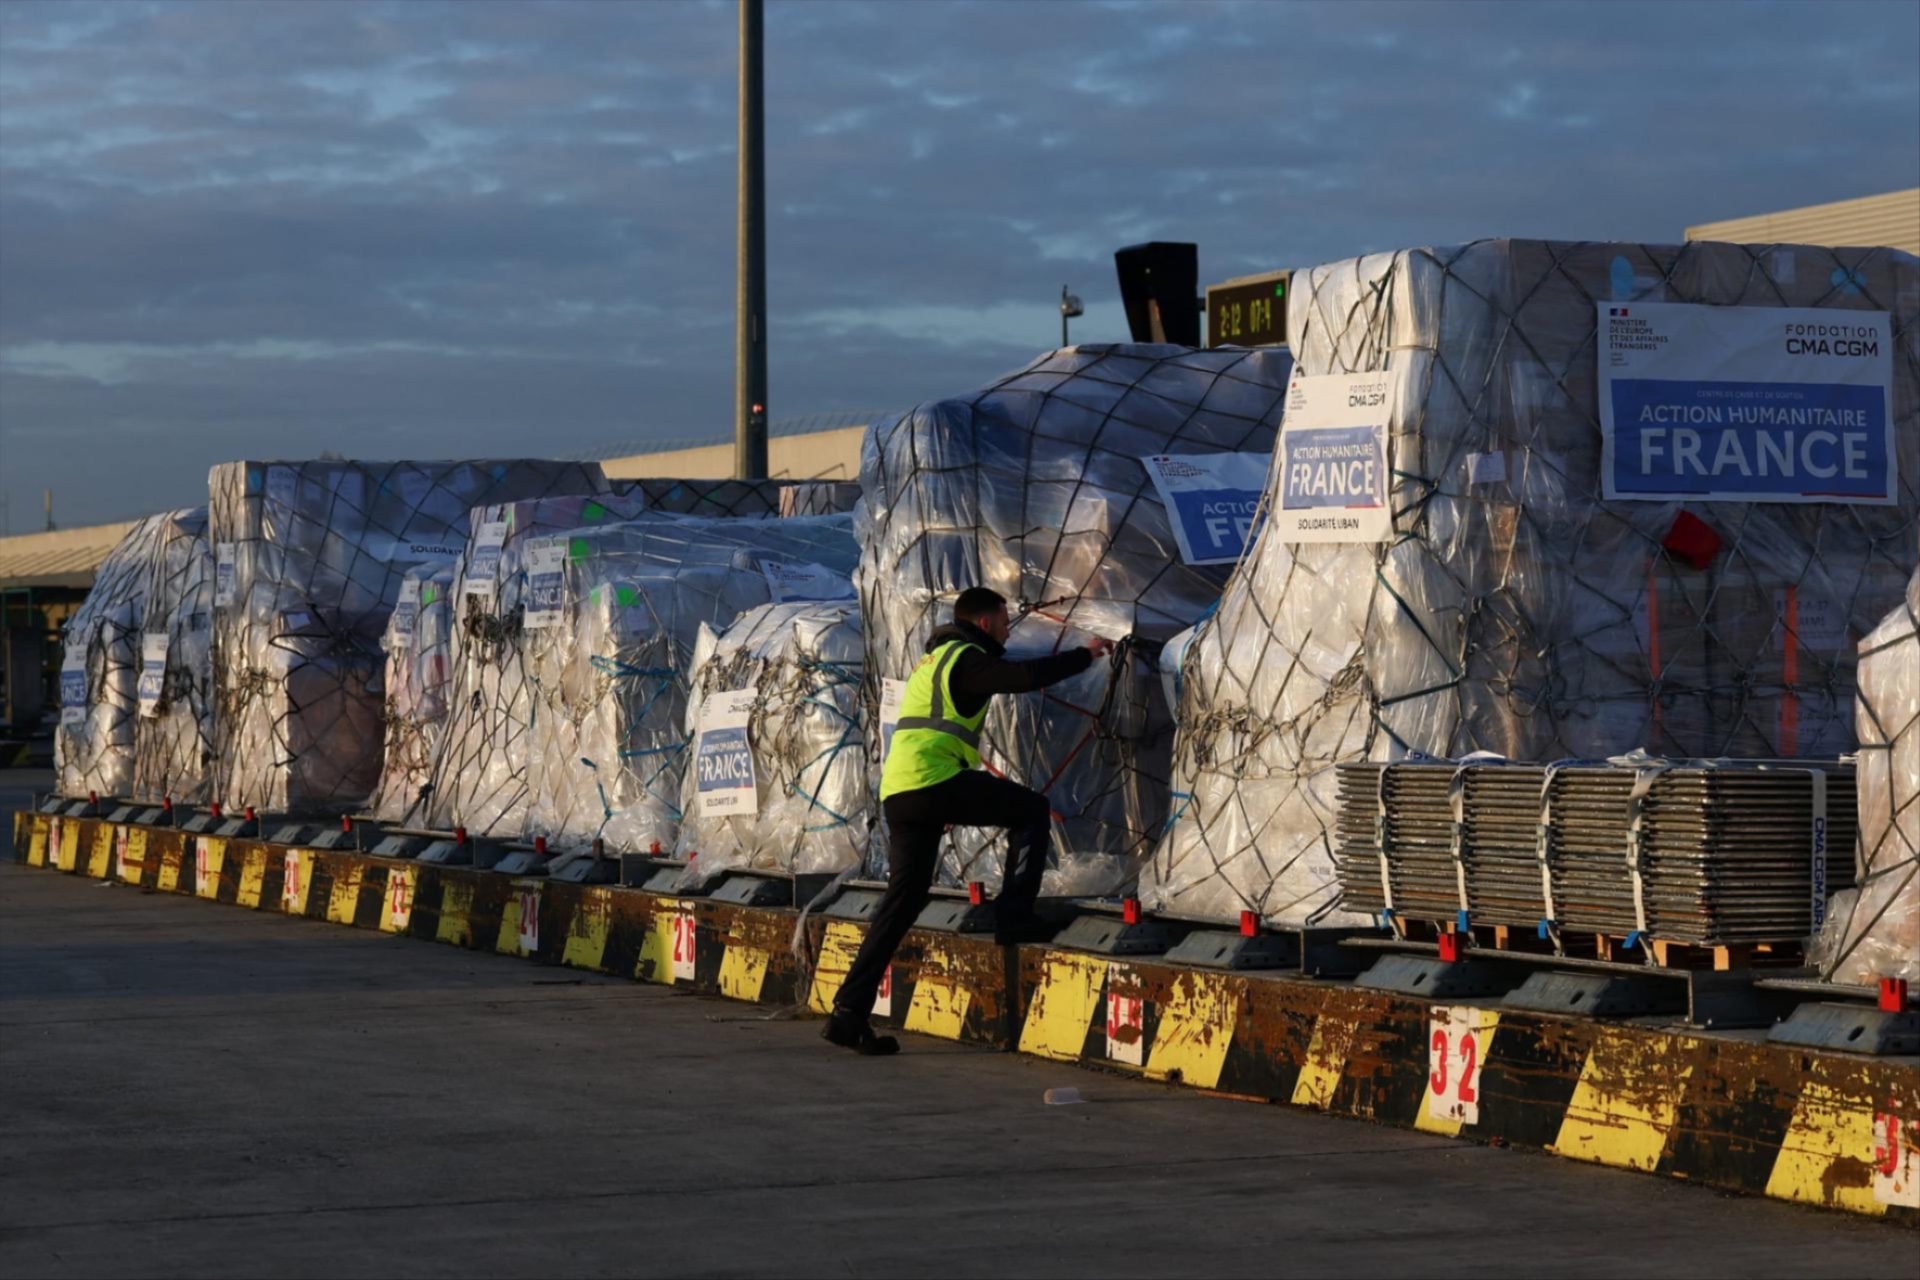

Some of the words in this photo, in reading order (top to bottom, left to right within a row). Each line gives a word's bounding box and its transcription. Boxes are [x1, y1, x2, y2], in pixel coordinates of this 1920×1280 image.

[1786, 338, 1831, 356] CMA
[1833, 340, 1879, 358] CGM
[1639, 404, 1722, 423] ACTION
[1728, 406, 1867, 427] HUMANITAIRE
[1293, 446, 1321, 460] ACTION
[1322, 443, 1373, 459] HUMANITAIRE
[1639, 427, 1869, 479] FRANCE
[1289, 460, 1374, 497] FRANCE
[1814, 817, 1825, 854] CMA
[1814, 856, 1825, 895] CGM
[673, 917, 695, 963] 26
[1430, 1029, 1476, 1102] 32
